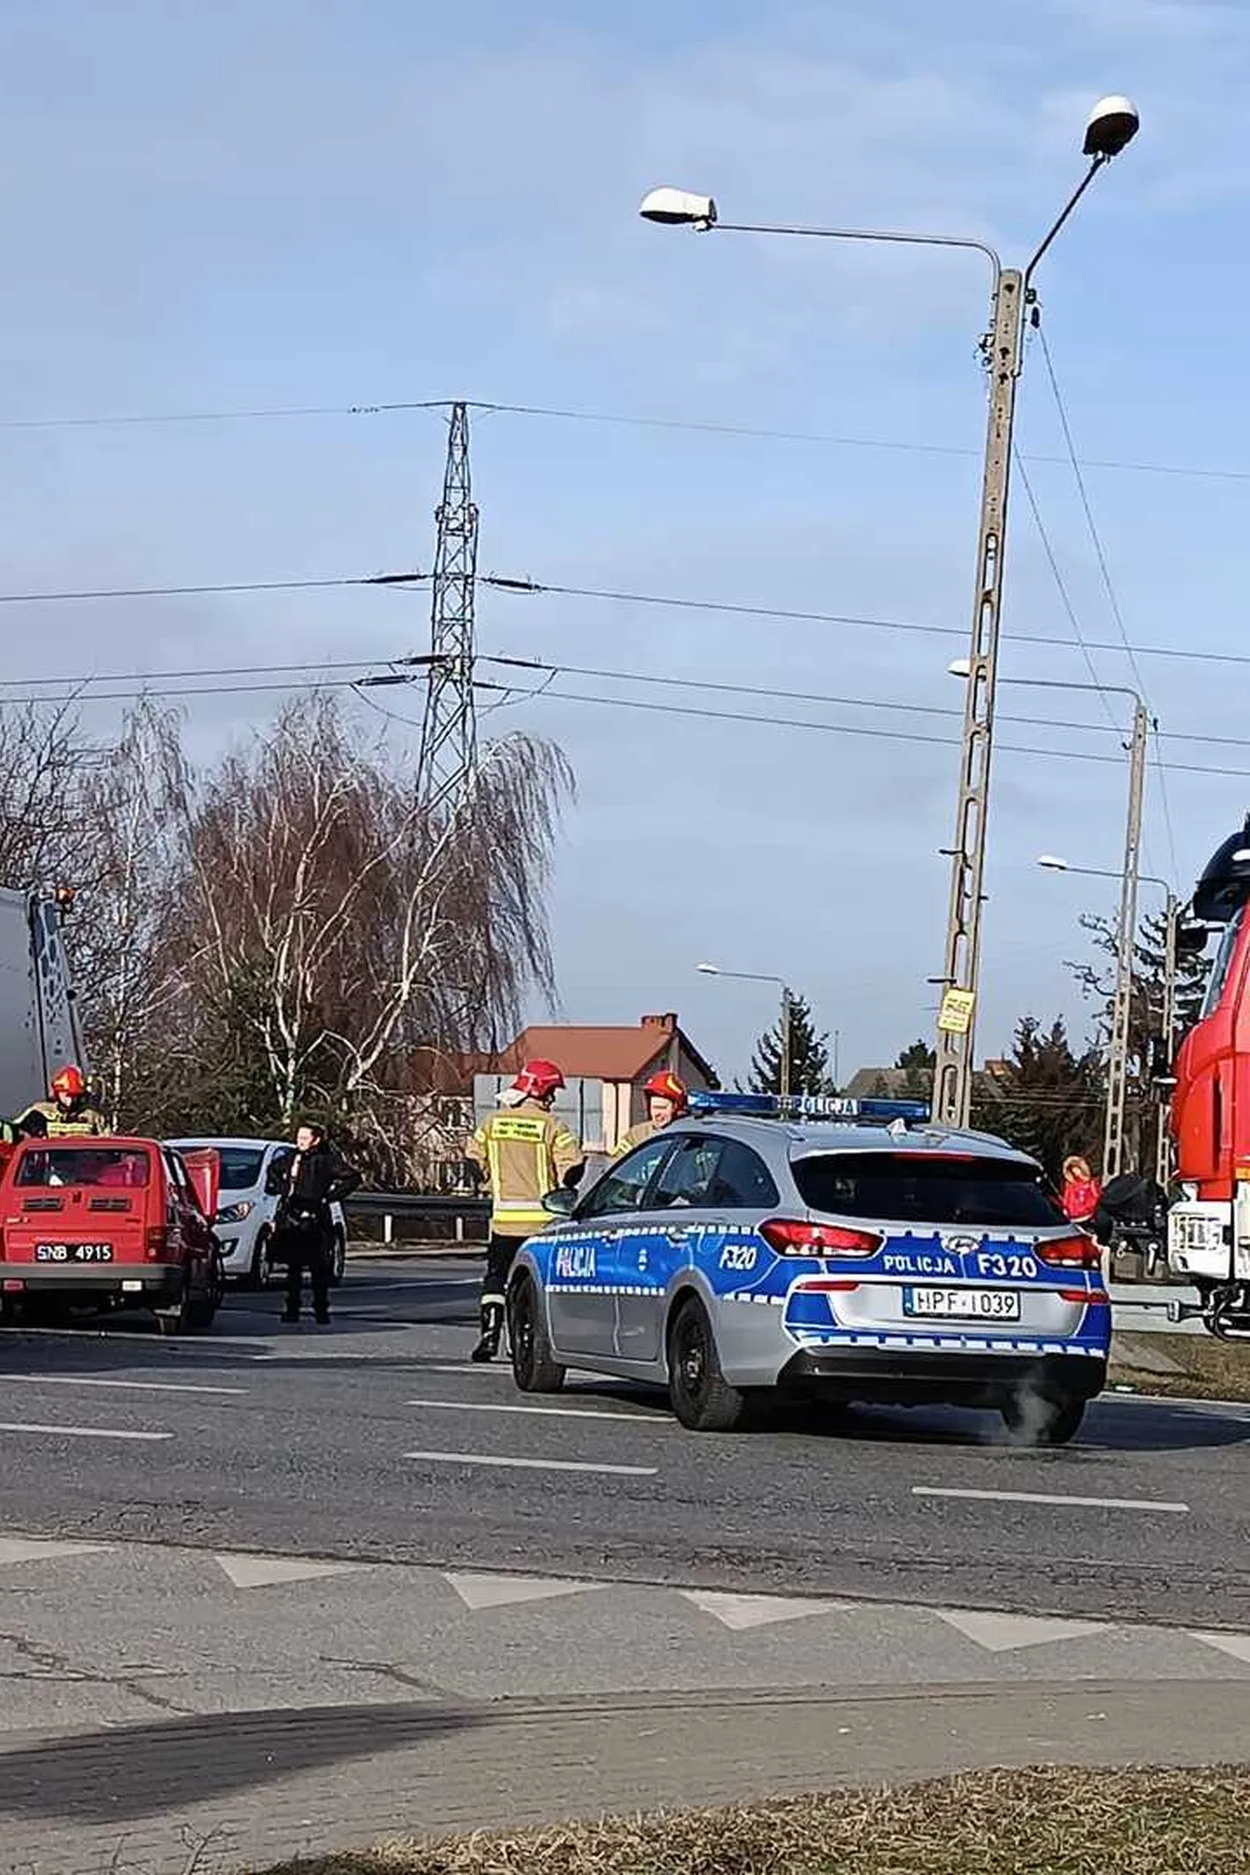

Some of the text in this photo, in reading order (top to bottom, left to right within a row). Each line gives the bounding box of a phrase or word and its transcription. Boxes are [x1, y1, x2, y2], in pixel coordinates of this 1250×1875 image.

[794, 1098, 859, 1115] POLICJA
[75, 1245, 112, 1260] 4915
[555, 1247, 597, 1278] POLICJA
[718, 1245, 758, 1271] F320
[883, 1253, 1038, 1279] POLICJA F320
[917, 1290, 959, 1312] HPF
